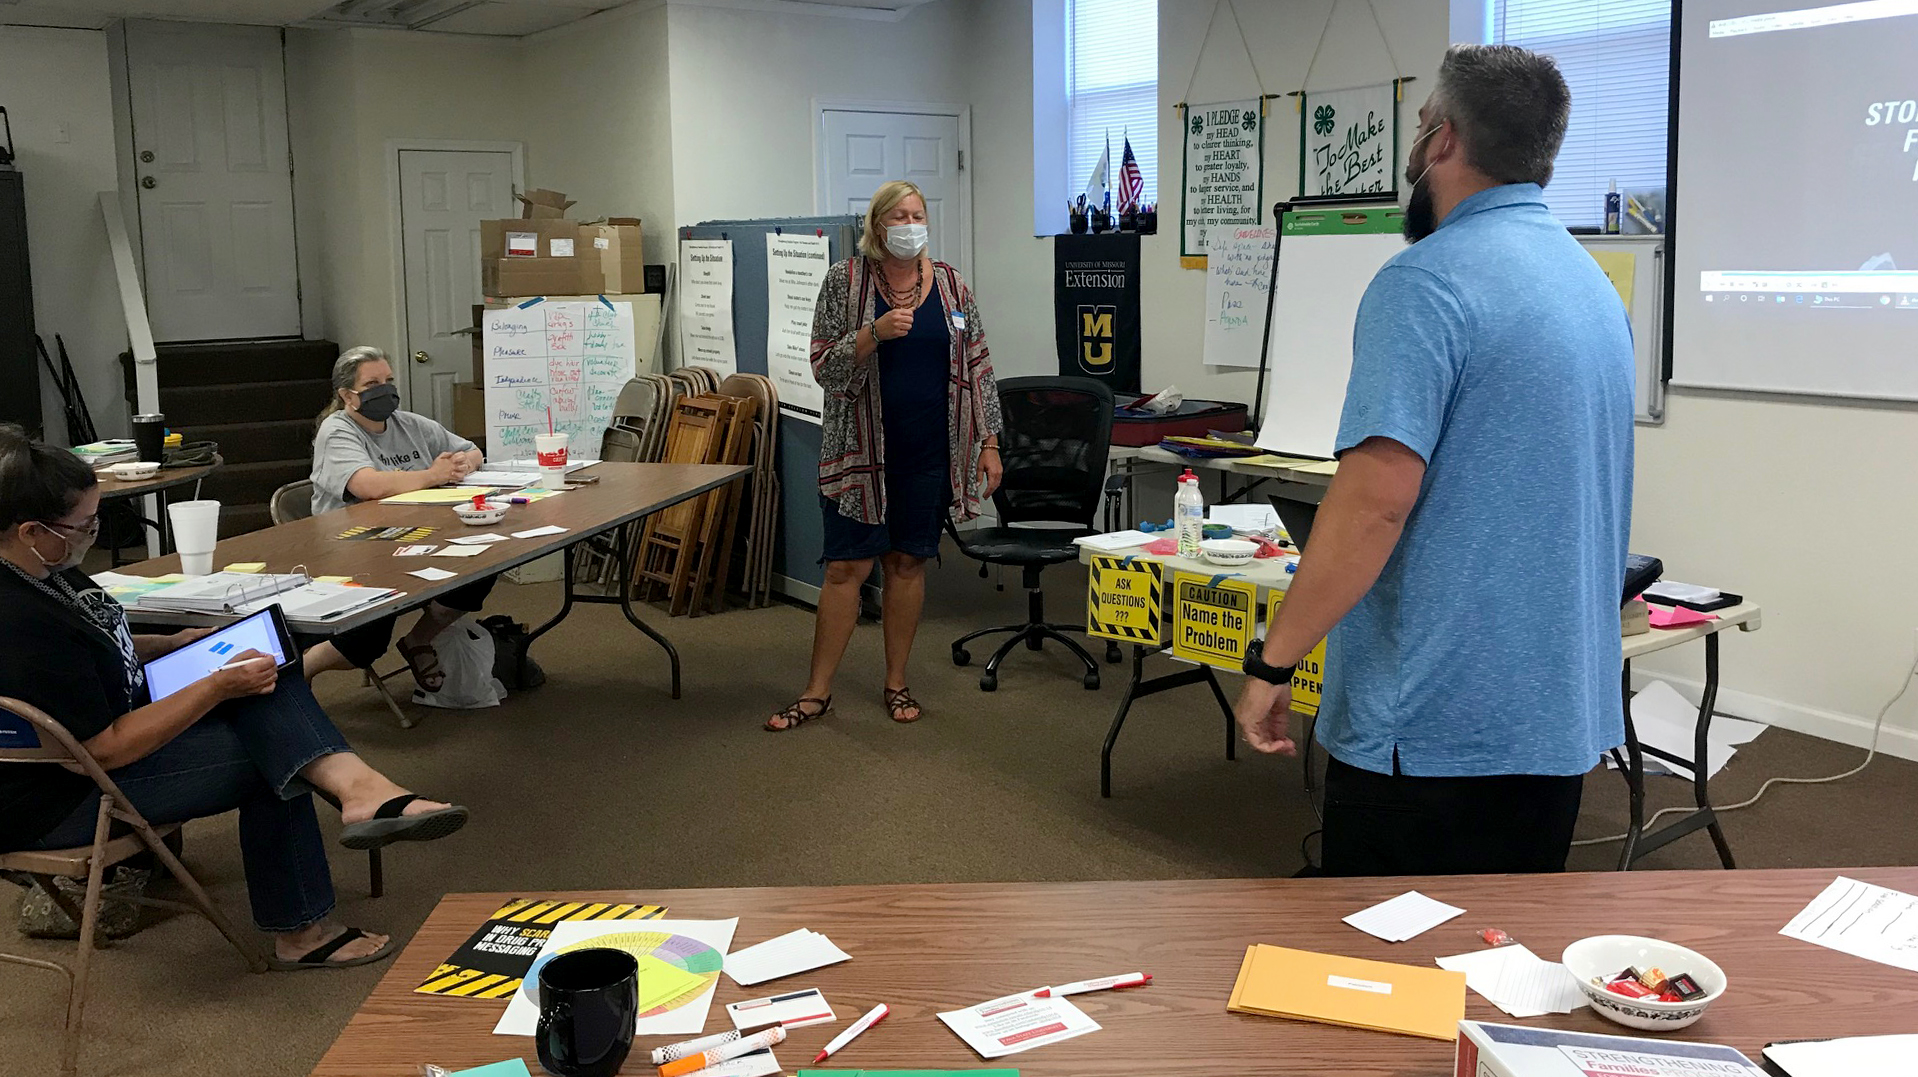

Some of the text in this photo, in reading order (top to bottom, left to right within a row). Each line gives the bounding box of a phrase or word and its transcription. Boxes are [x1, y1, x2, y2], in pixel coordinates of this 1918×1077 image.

[1206, 109, 1240, 127] I PLEDGE
[1865, 99, 1918, 126] STO
[1206, 127, 1239, 141] my HEAD
[1337, 111, 1385, 160] Make
[1193, 142, 1200, 150] to
[1223, 137, 1254, 149] thinking,
[1212, 149, 1240, 160] HEART
[1225, 160, 1249, 171] loyalty,
[1343, 142, 1383, 187] Best
[1211, 172, 1241, 182] HANDS
[1320, 171, 1341, 195] the
[1214, 182, 1240, 193] service,
[1241, 182, 1255, 191] and
[1207, 194, 1242, 205] HEALTH
[1193, 207, 1200, 215] to
[1217, 205, 1239, 216] living,
[1240, 205, 1251, 214] for
[1186, 219, 1197, 227] my
[1207, 218, 1219, 227] my
[1220, 216, 1257, 226] community,
[1065, 261, 1094, 269] UNIVERSITY
[1101, 260, 1126, 268] MISSOURI
[1065, 269, 1125, 288] Extension
[390, 453, 411, 466] like
[412, 450, 421, 460] a
[1115, 577, 1132, 591] ASK
[1101, 592, 1146, 609] QUESTIONS
[1188, 586, 1238, 607] CAUTION
[1115, 610, 1129, 623] ???
[1183, 602, 1243, 631] Name the
[1185, 625, 1239, 653] Problem
[490, 924, 520, 936] WHY
[482, 932, 495, 942] IN
[495, 934, 528, 946] DRUG
[473, 941, 538, 956] MESSAGING
[1572, 1049, 1742, 1075] STRENGTHENING
[1585, 1060, 1660, 1077] Families
